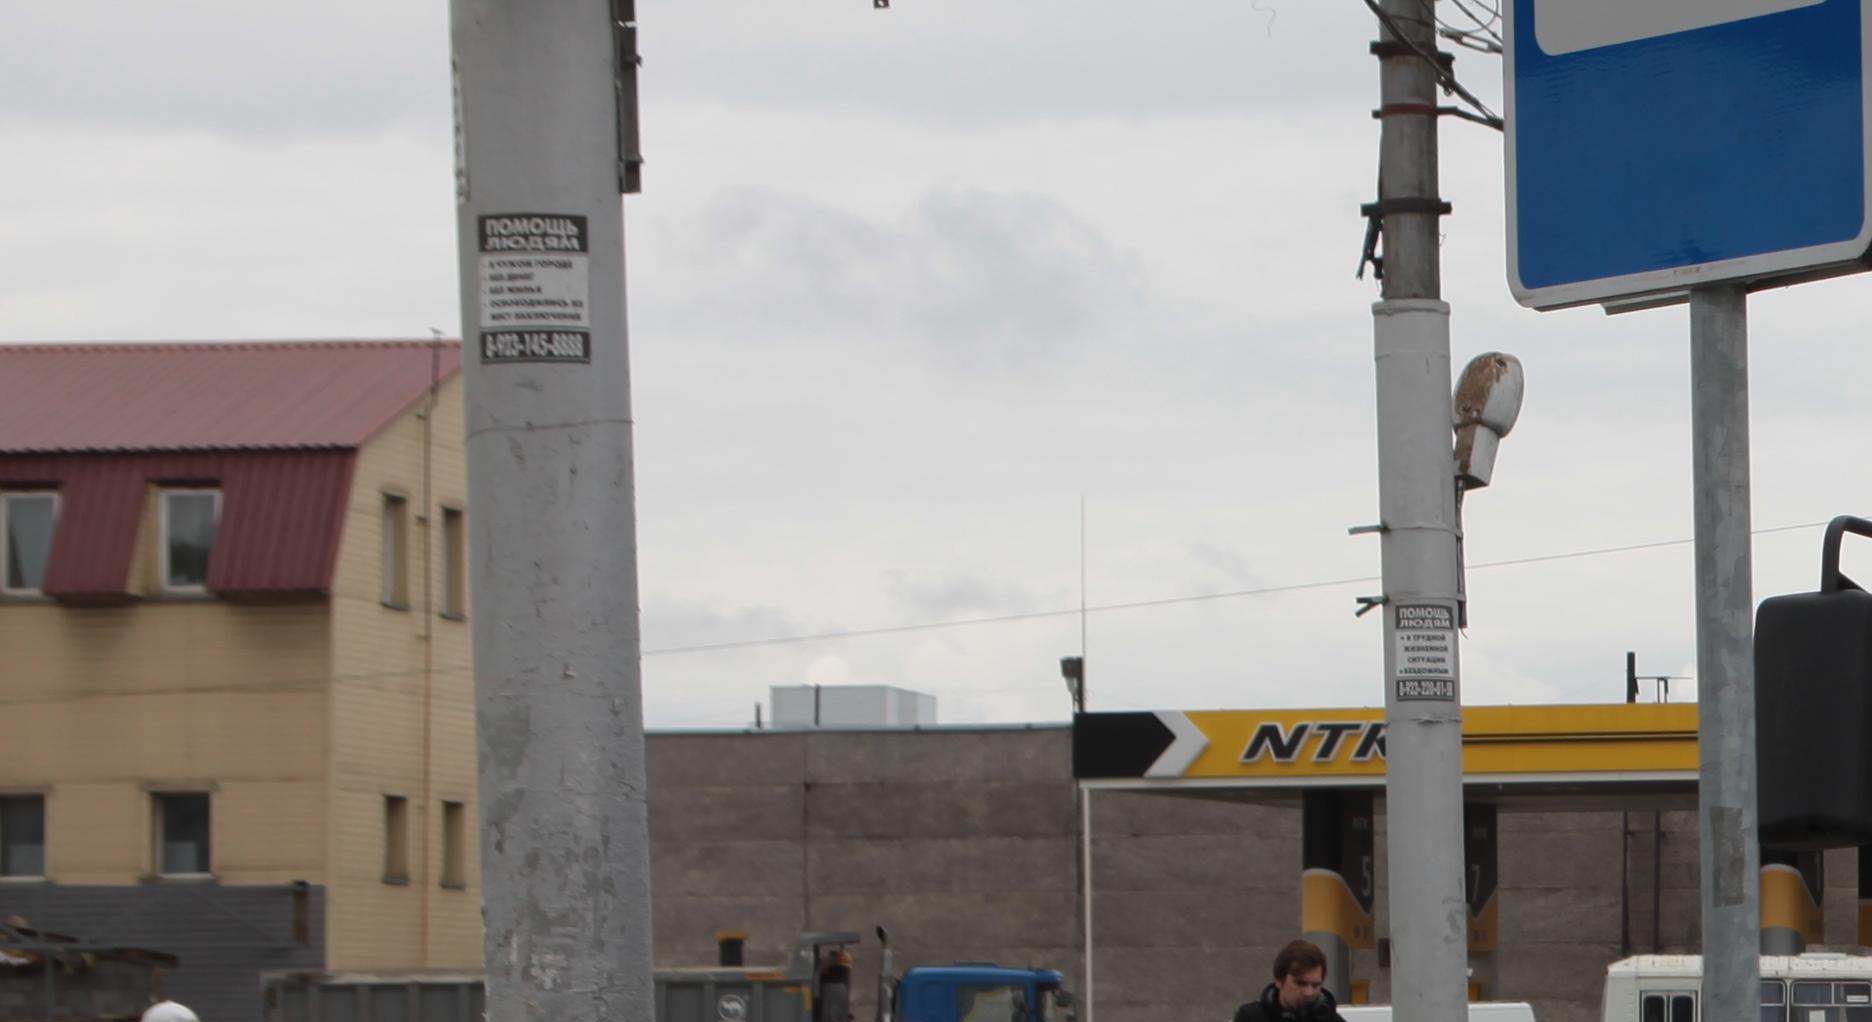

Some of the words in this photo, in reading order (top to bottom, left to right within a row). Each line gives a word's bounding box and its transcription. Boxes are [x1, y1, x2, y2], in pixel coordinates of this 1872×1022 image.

[485, 217, 579, 236] ПОМОЩЬ
[485, 235, 581, 251] ЛЮДЯМ
[1400, 607, 1450, 619] ПОМОЩЬ
[1400, 619, 1450, 629] ЛЮДЯМ
[1361, 855, 1372, 897] 5
